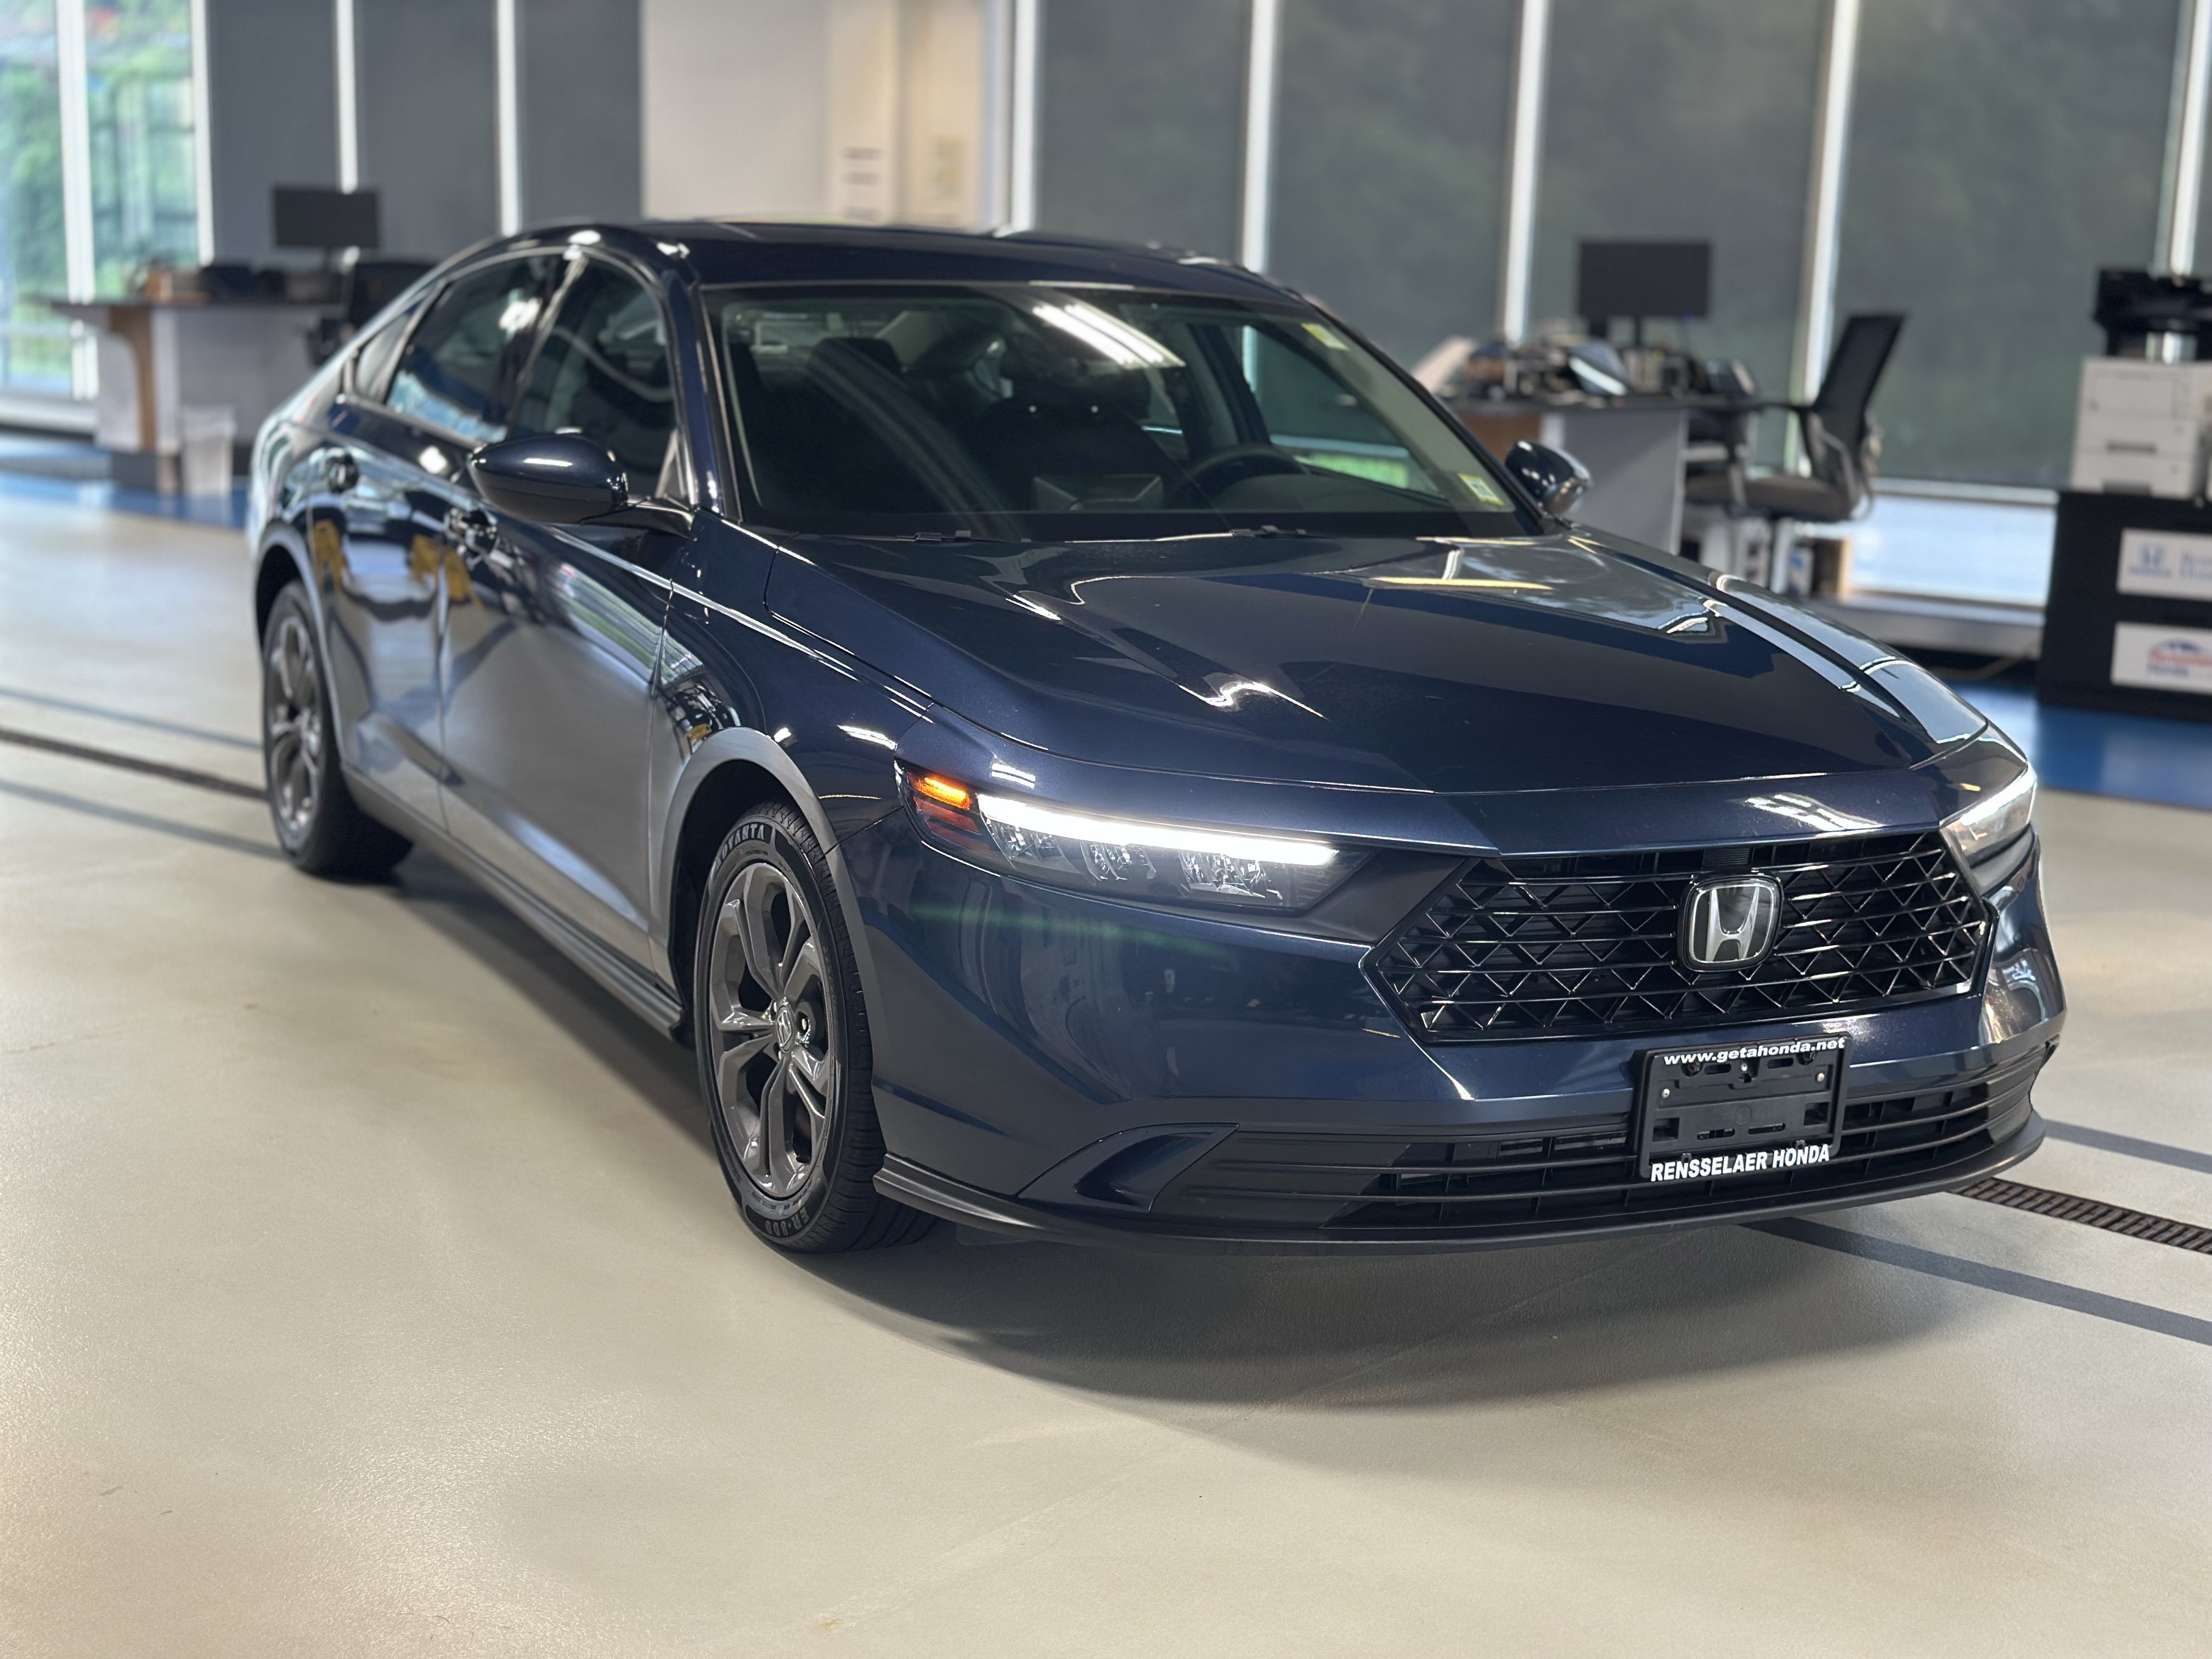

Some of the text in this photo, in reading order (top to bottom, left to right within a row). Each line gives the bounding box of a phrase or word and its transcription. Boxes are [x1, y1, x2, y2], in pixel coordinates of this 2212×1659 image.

[1664, 1037, 1845, 1065] www.getahonda.net
[1651, 1144, 1830, 1181] RENSSELAER HONDA
